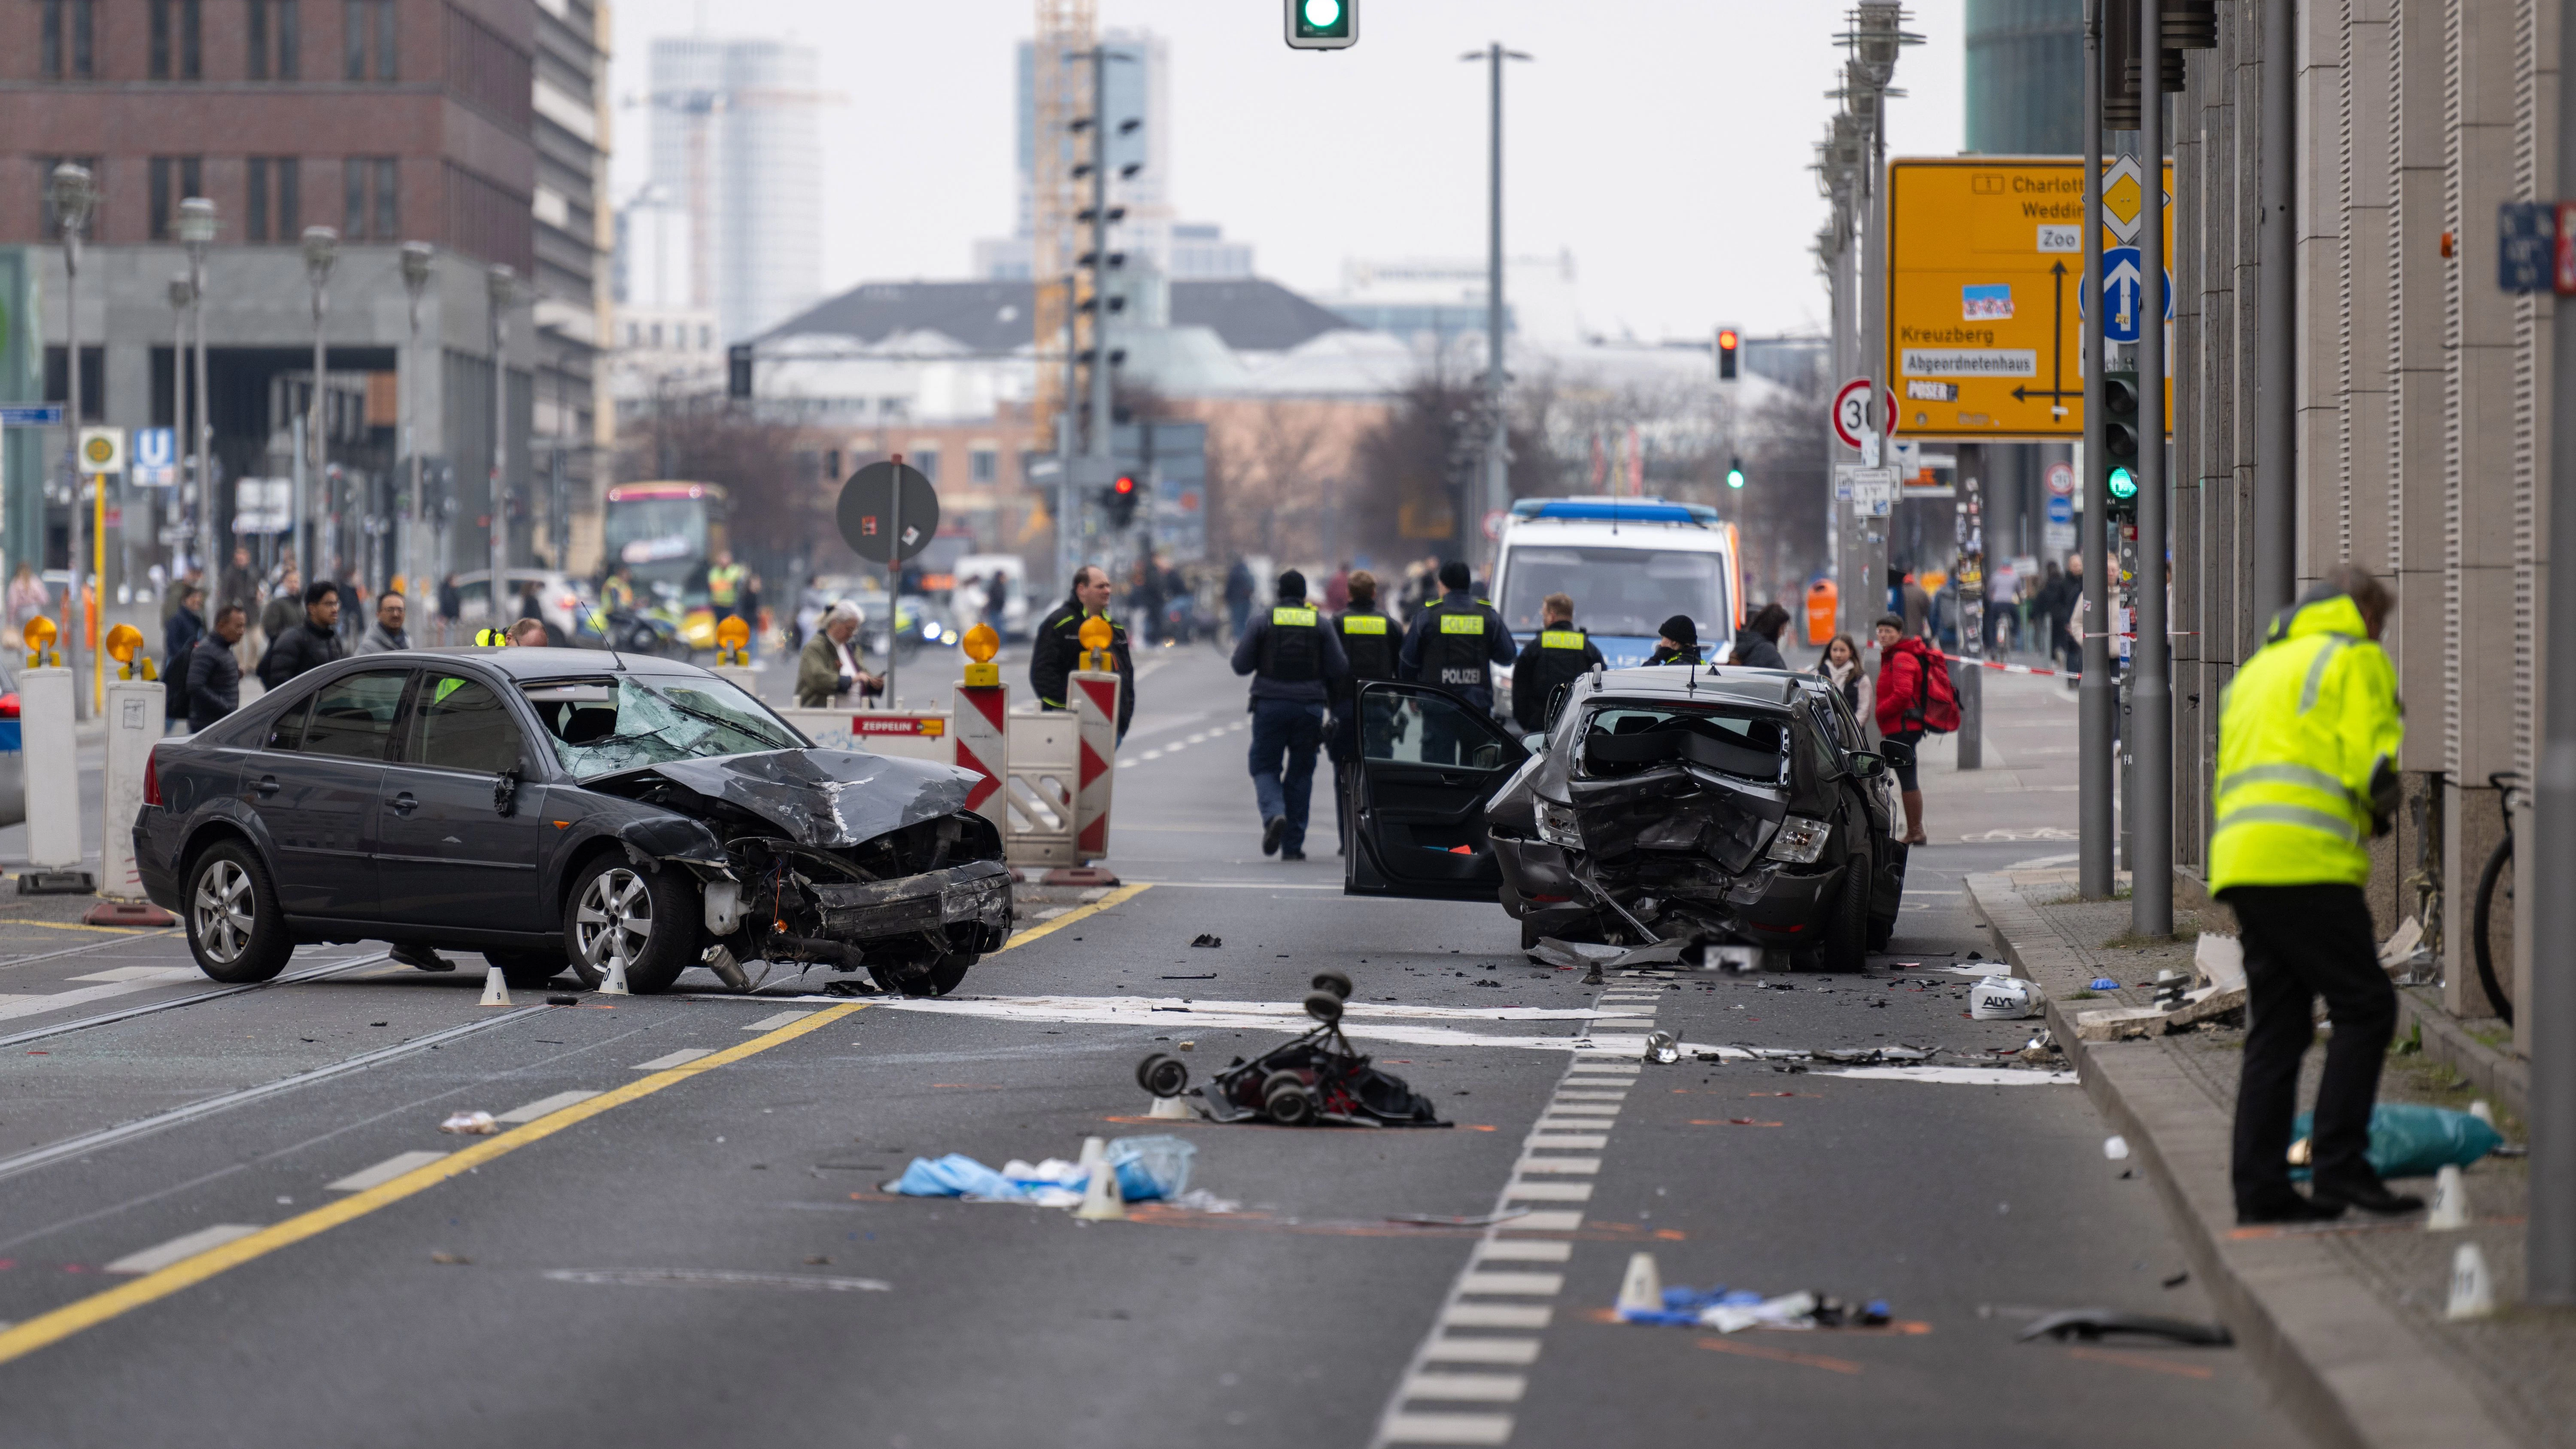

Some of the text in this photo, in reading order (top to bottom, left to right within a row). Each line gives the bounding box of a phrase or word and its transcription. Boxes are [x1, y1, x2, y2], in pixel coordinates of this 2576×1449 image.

[2043, 229, 2075, 247] Zoo
[1901, 325, 1994, 347] Kreuzberg
[1908, 353, 2032, 375] Abgeordnetenhaus
[140, 428, 168, 465] U
[1274, 610, 1315, 625] POLIZEI
[1443, 617, 1483, 632] POLIZEI
[1345, 619, 1385, 633] POLIZEI
[1544, 634, 1583, 648] POLIZEI
[1442, 668, 1481, 684] POLIZEI
[862, 721, 912, 731] ZEPPELIN
[617, 981, 623, 990] 10
